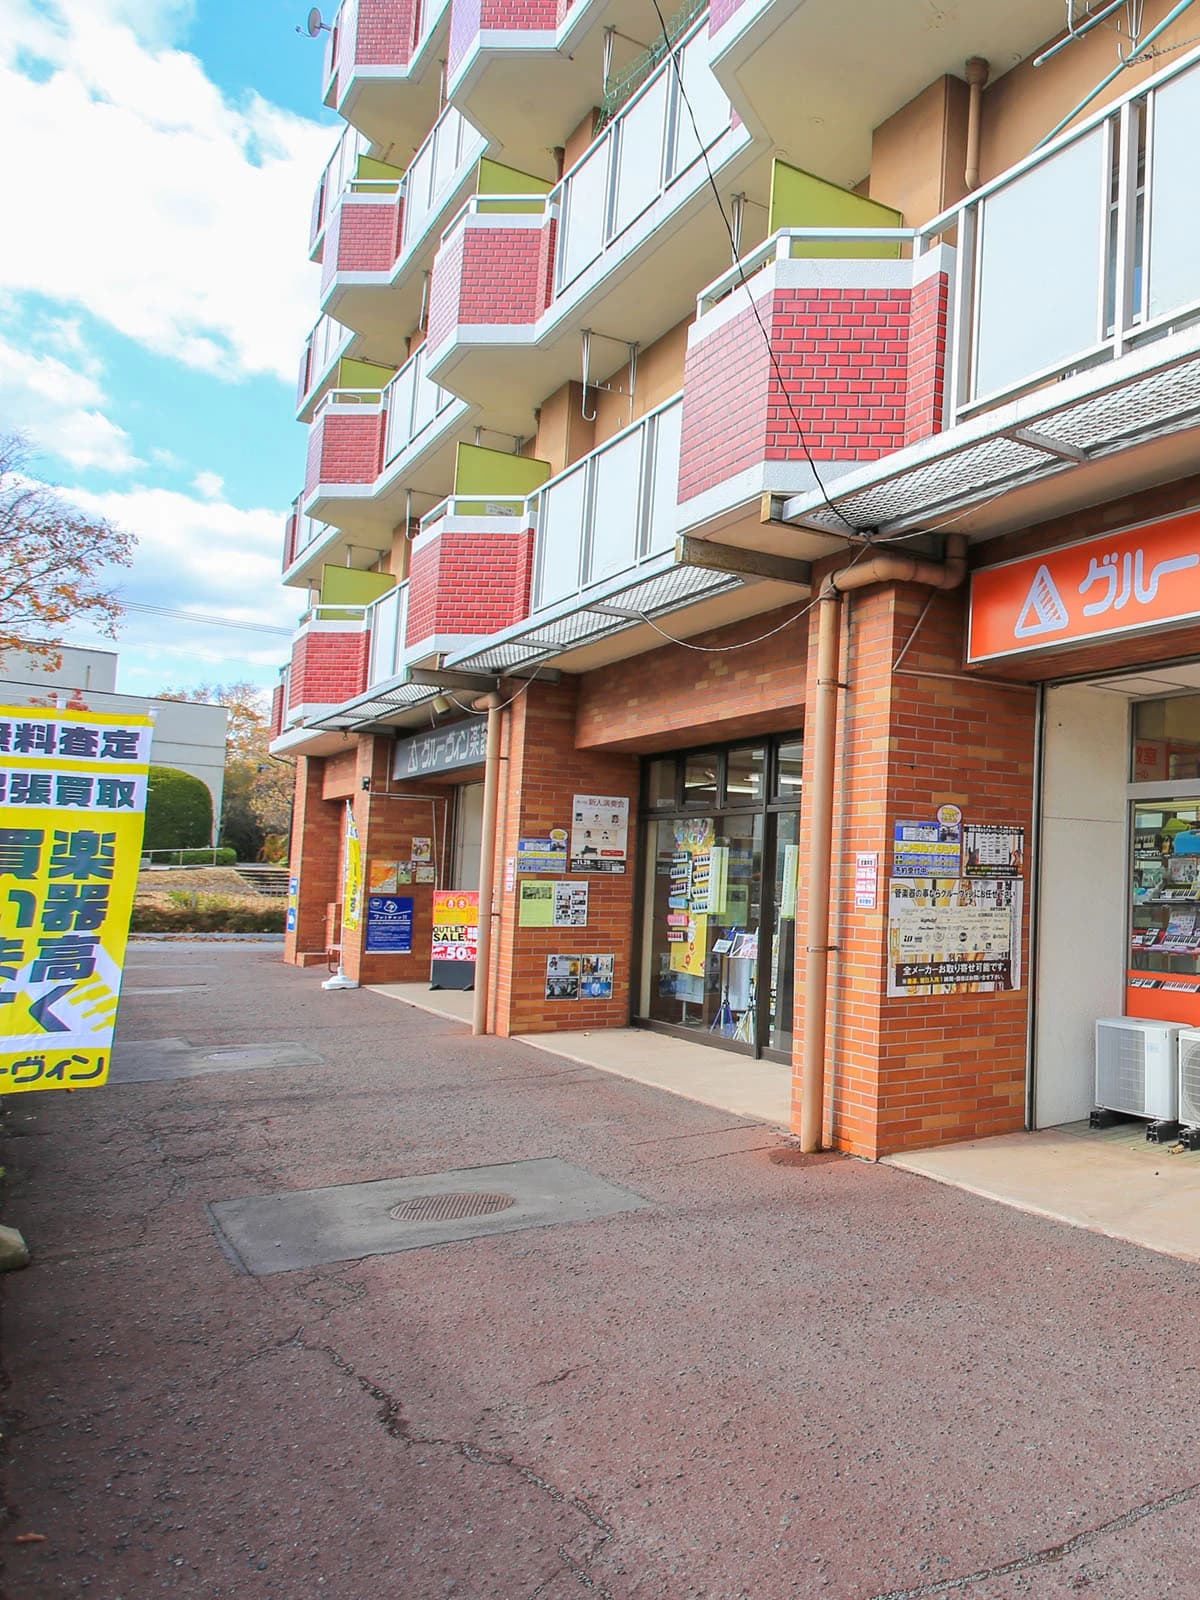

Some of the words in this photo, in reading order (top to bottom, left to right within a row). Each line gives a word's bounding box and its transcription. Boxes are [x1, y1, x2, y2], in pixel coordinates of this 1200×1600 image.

[0, 772, 137, 809] 張買取
[28, 829, 117, 1033] 楽器高く
[433, 933, 465, 942] SALE
[902, 962, 1008, 976] 全メーカーお取り寄せ可能です。
